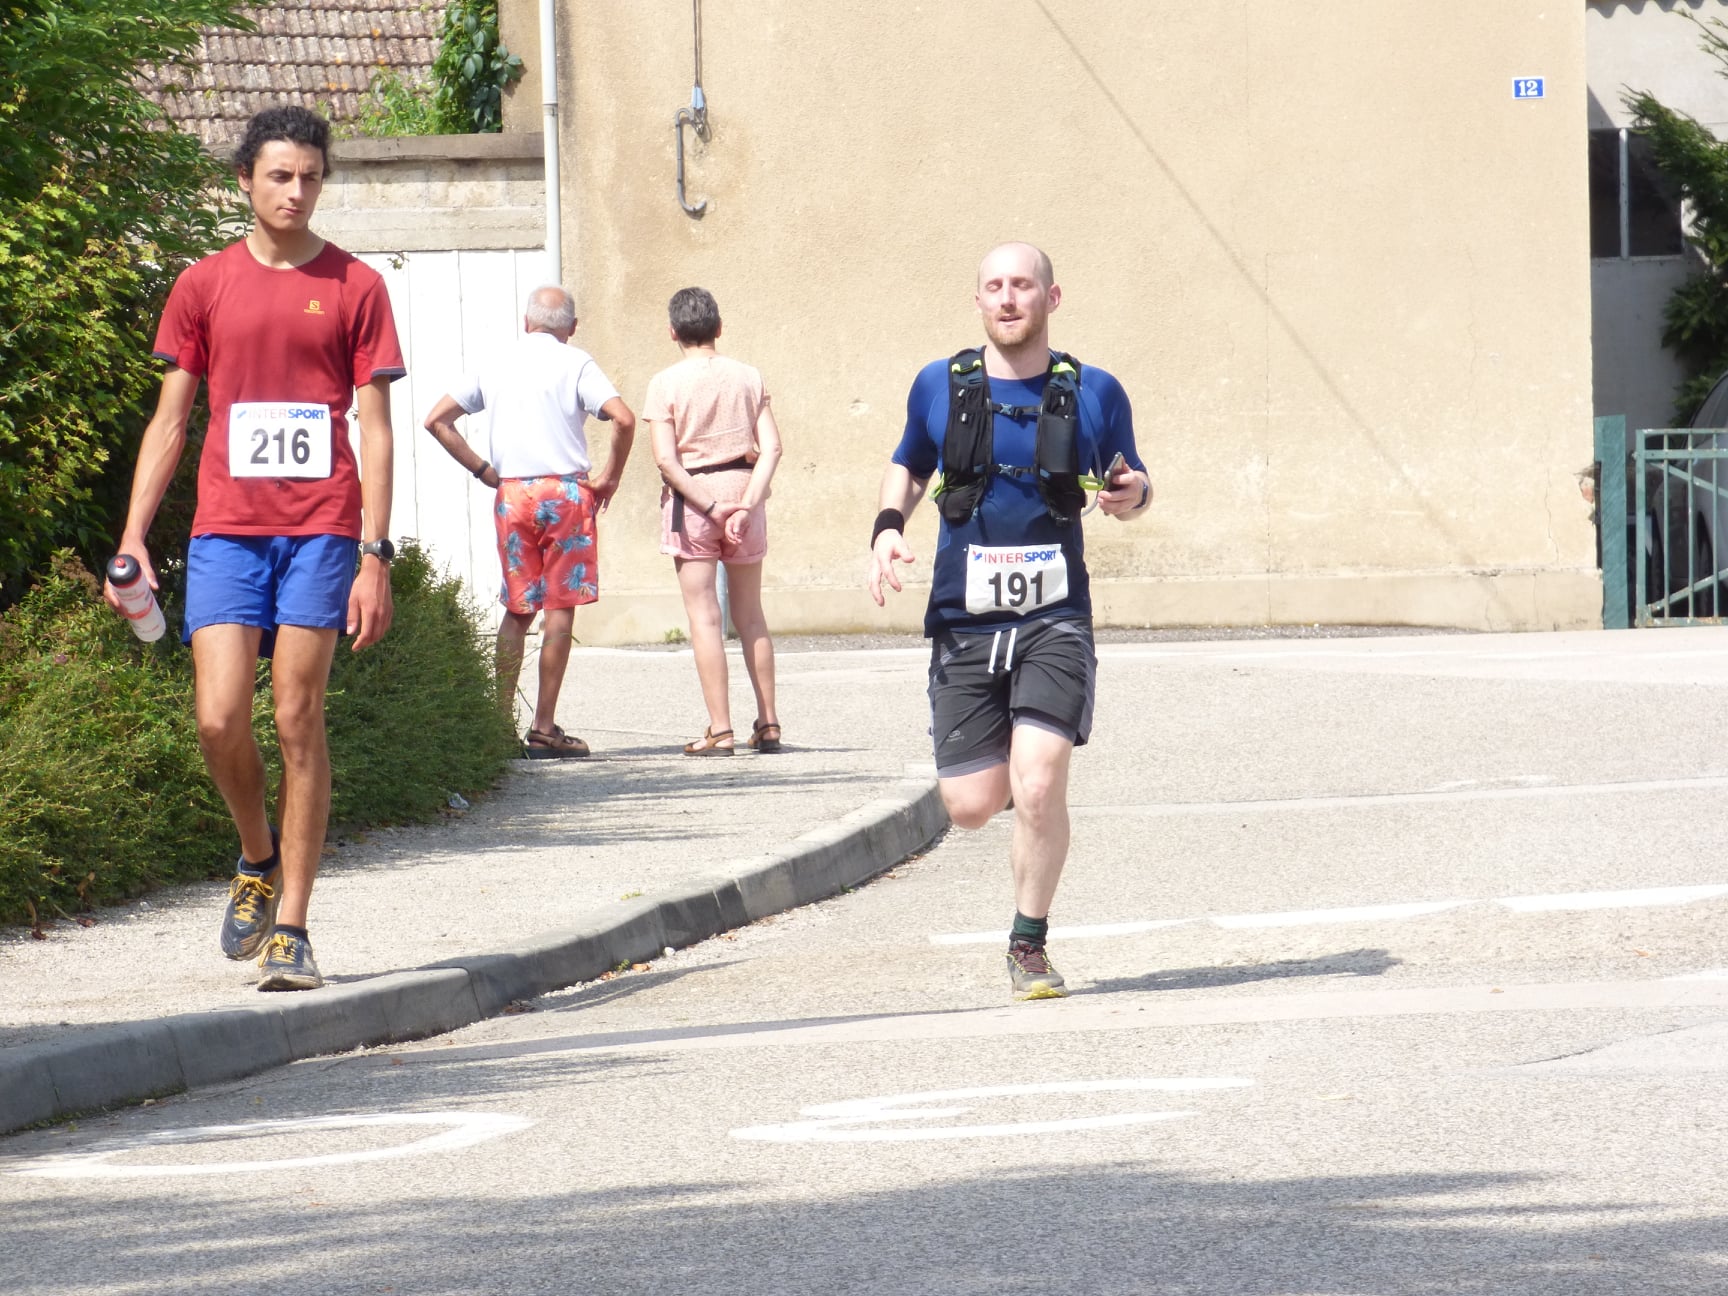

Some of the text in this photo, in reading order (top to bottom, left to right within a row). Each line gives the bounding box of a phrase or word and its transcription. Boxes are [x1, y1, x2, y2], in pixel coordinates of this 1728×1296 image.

[1518, 80, 1538, 96] 12
[248, 408, 325, 420] INTERSPORT
[250, 427, 310, 465] 216
[984, 549, 1057, 564] INTERSPORT
[987, 571, 1043, 608] 191
